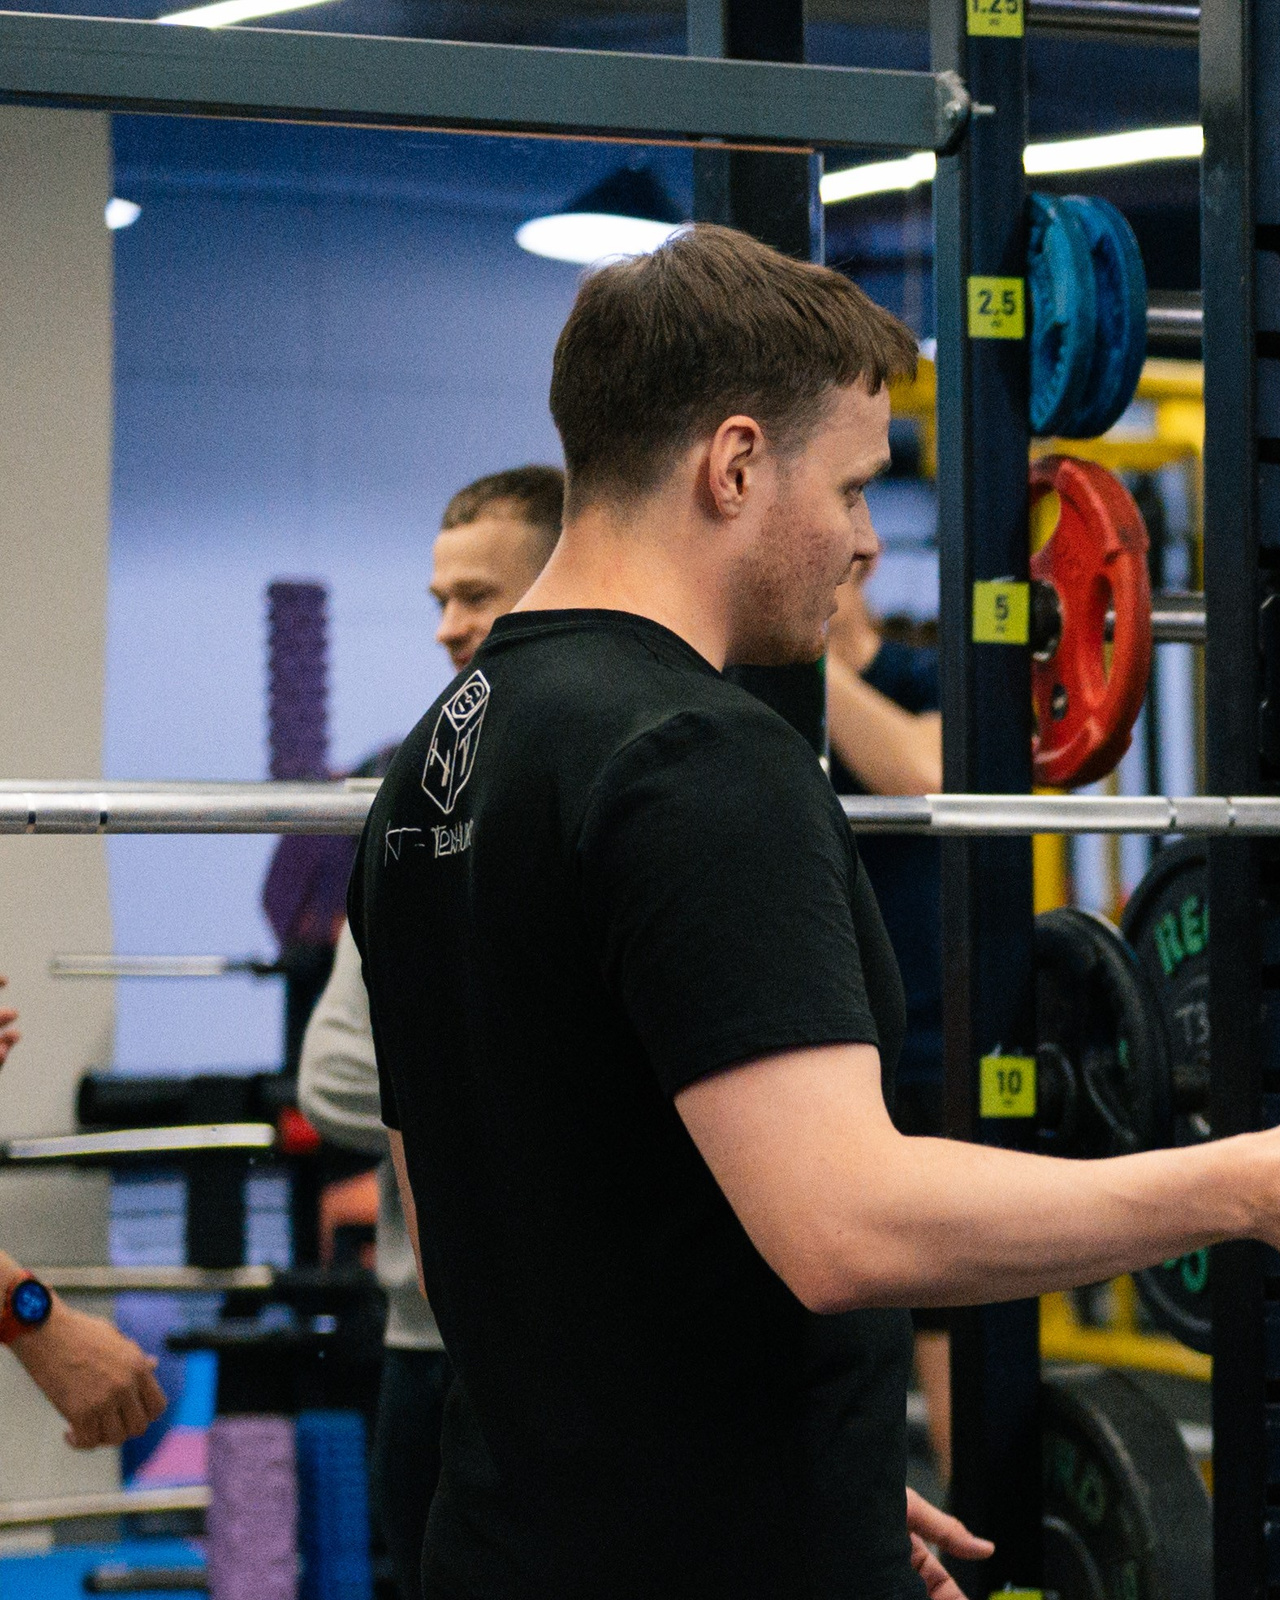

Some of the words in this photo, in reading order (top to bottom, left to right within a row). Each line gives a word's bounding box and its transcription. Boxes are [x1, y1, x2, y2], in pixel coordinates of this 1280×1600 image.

[978, 289, 1016, 316] 2.5
[995, 593, 1009, 620] 5
[997, 1069, 1022, 1095] 10
